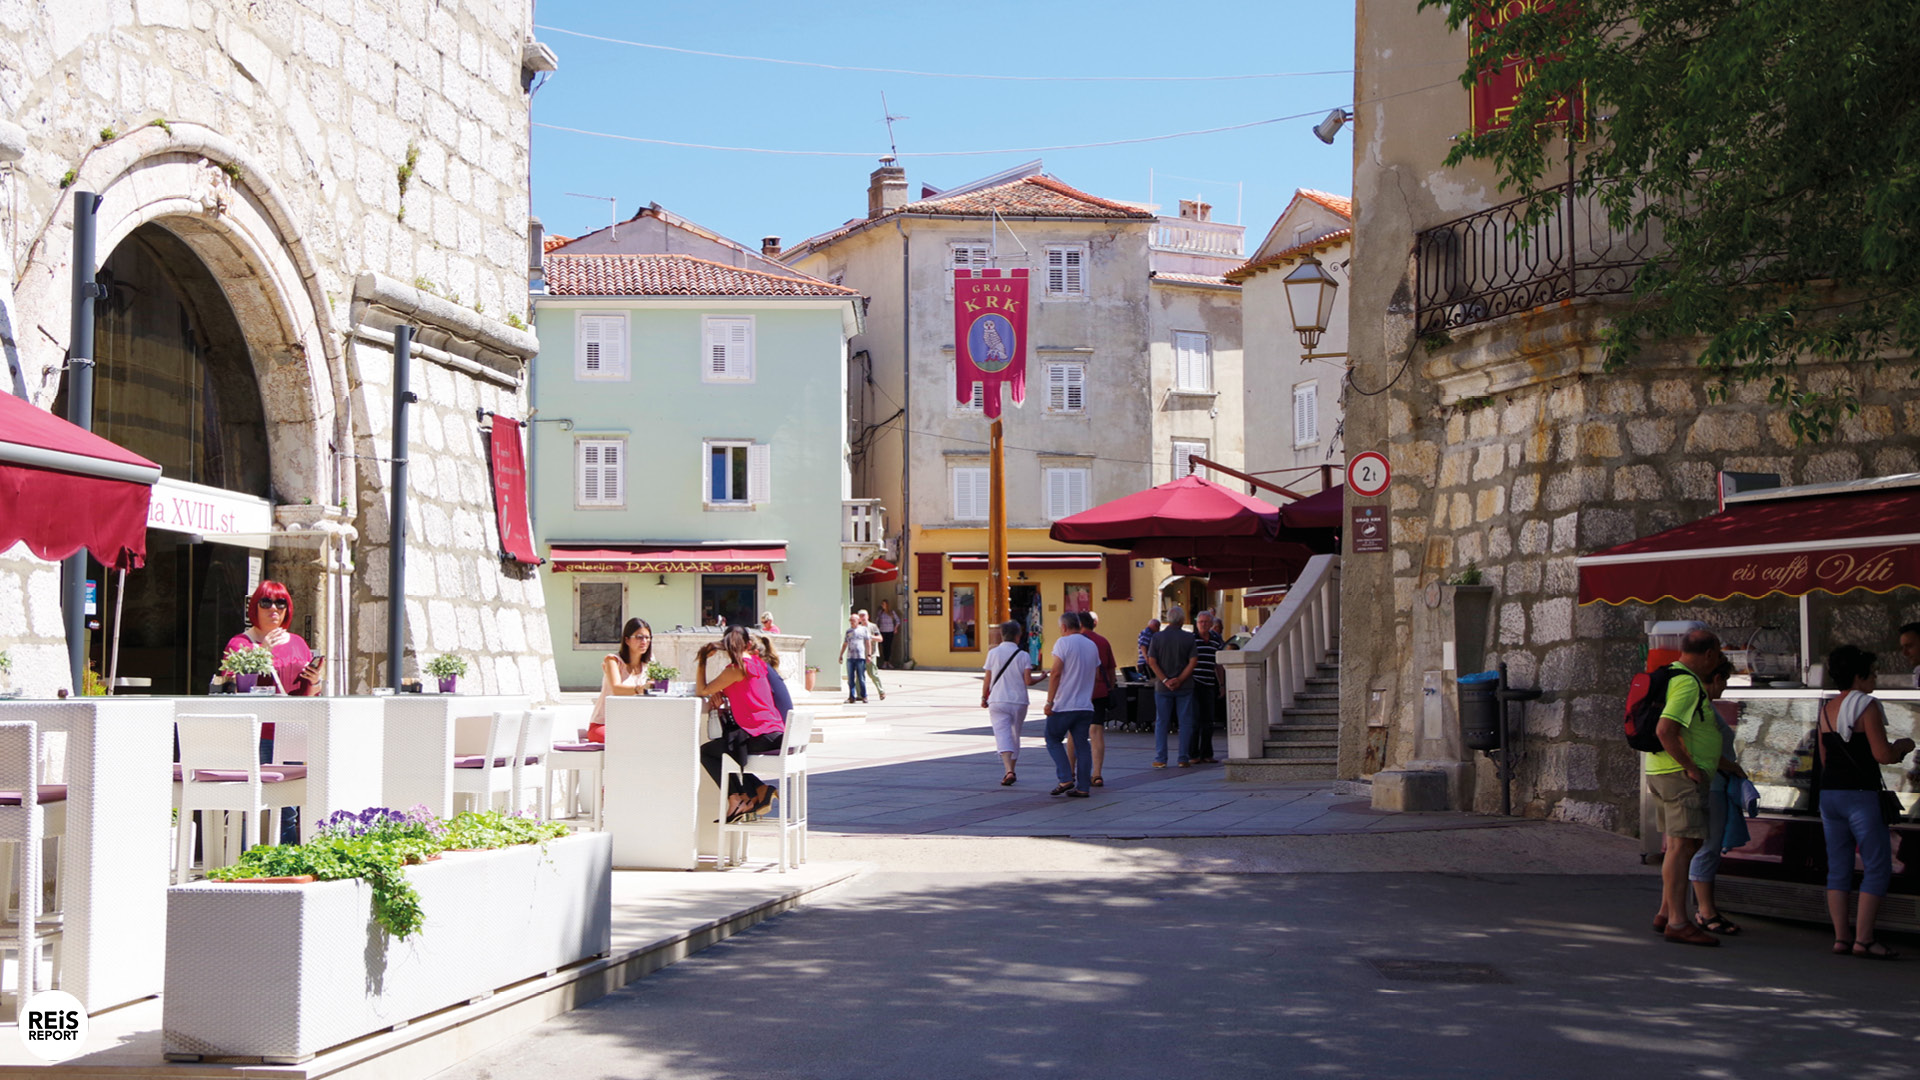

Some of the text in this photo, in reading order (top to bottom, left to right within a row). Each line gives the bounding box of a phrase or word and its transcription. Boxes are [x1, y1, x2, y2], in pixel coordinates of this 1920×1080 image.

[972, 284, 1011, 293] GRAD
[964, 295, 1020, 313] KRK
[1362, 466, 1370, 481] 2
[171, 497, 240, 534] XVIII.st.
[565, 561, 615, 573] galerija
[625, 561, 713, 573] DAGMAR
[1732, 563, 1759, 582] eis
[1815, 548, 1907, 585] Vili
